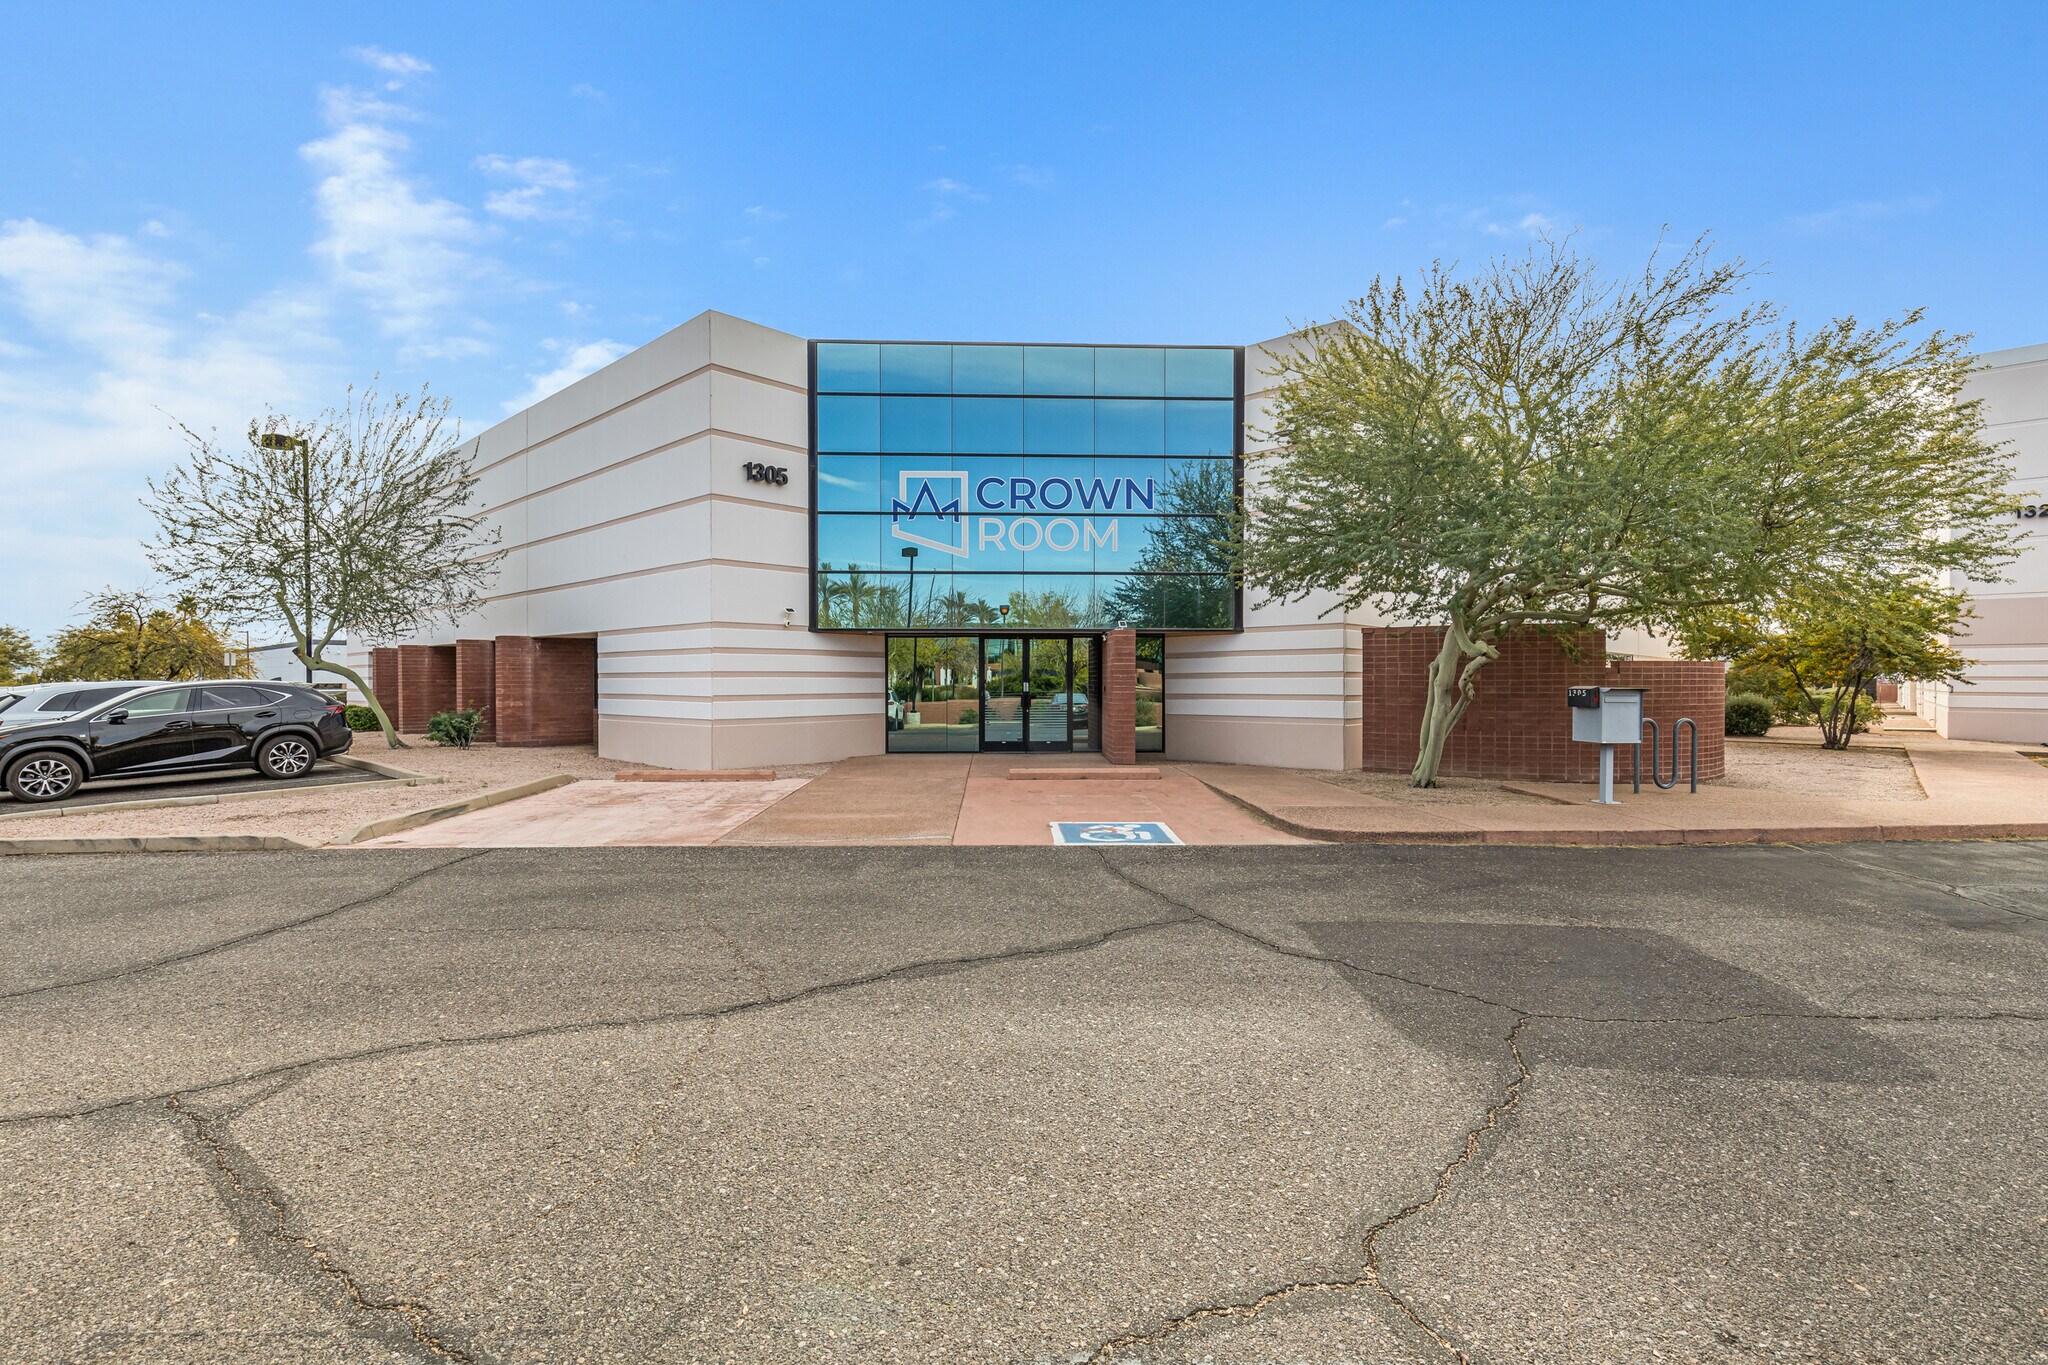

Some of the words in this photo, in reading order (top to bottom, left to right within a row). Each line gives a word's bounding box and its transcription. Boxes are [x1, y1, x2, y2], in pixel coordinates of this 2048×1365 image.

[742, 462, 788, 486] 1305
[976, 477, 1155, 510] CROWN
[978, 517, 1119, 552] ROOM
[1568, 689, 1587, 697] 1305
